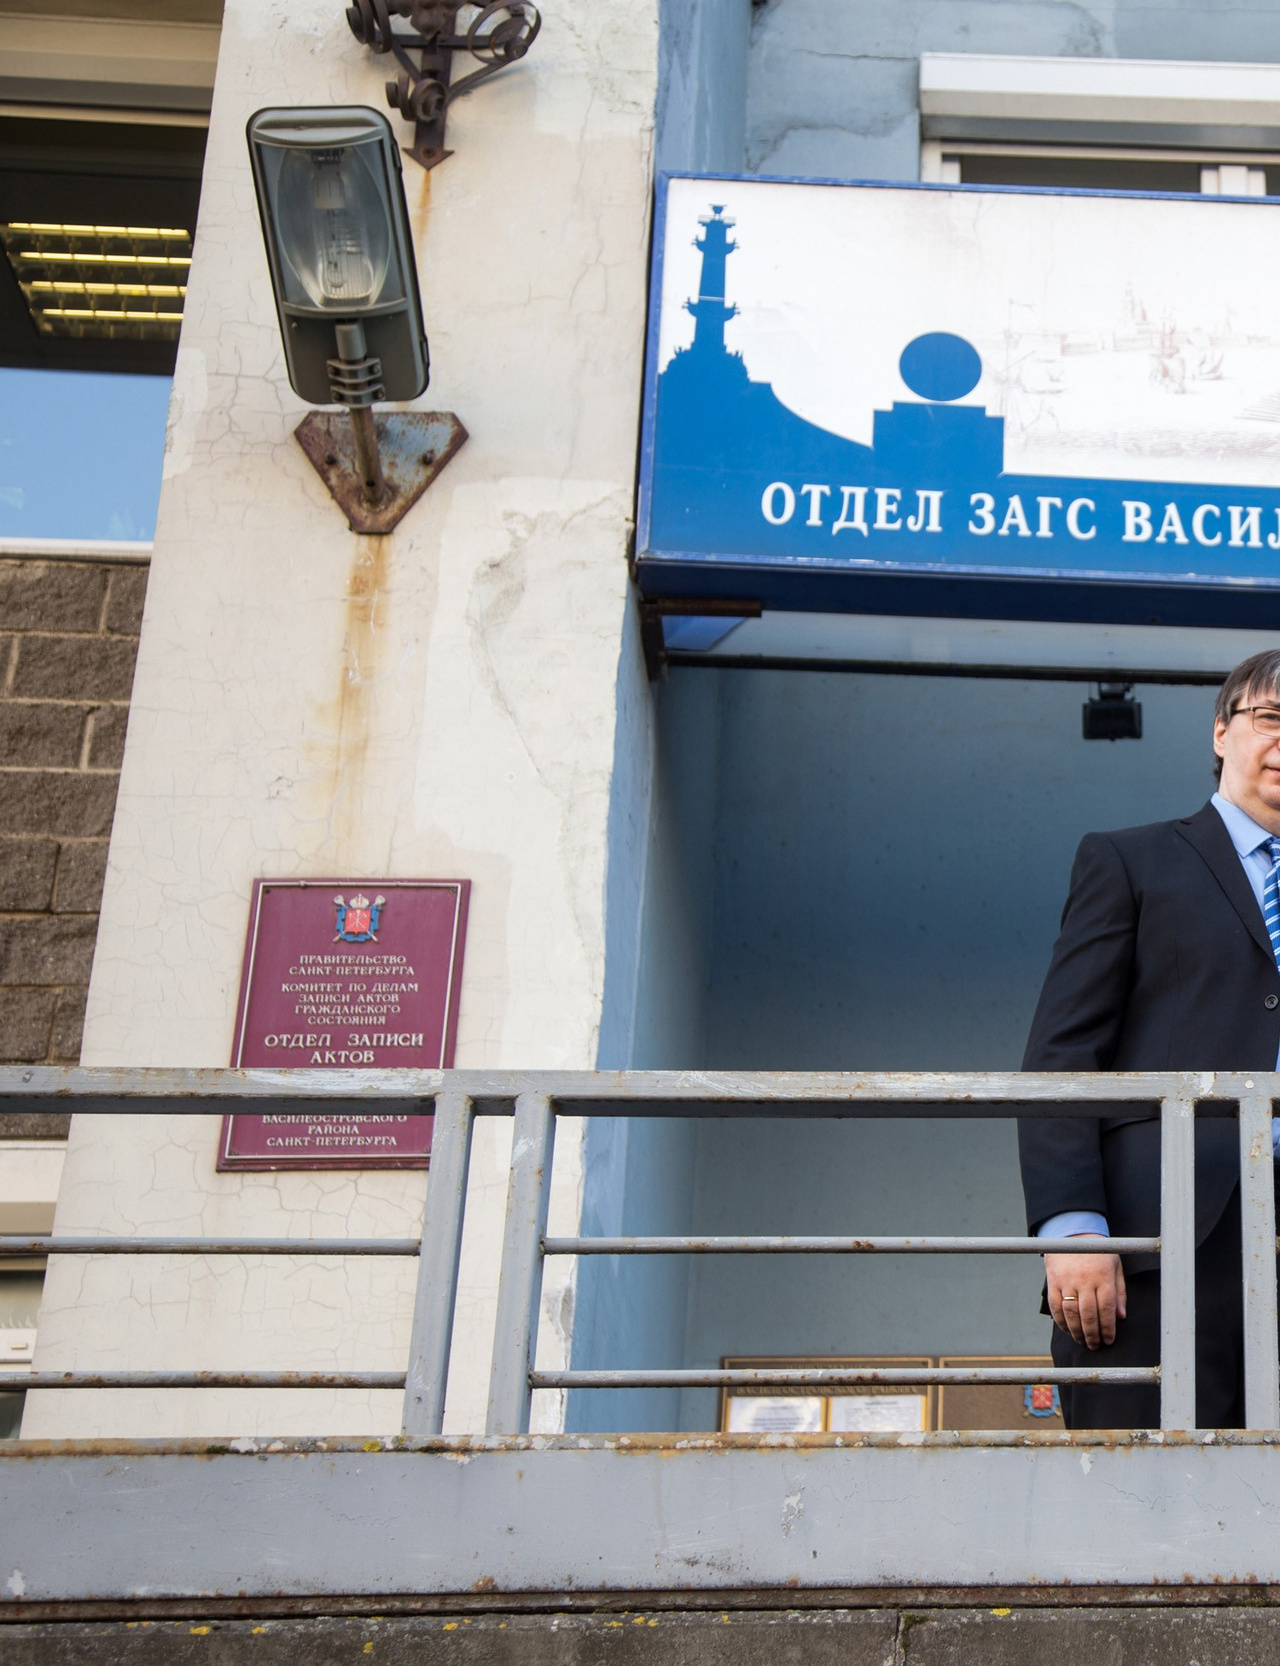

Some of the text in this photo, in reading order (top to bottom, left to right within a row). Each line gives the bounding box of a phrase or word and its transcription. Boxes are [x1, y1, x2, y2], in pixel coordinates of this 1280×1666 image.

[760, 480, 943, 538] ОТДЕЛ
[967, 491, 1098, 541] ЗАГС
[299, 954, 407, 965] ПРАВИТЕЛЬСТВО
[288, 966, 415, 976] САНКТ-ПЕТЕРБУРГА
[281, 982, 419, 993] КОМИТЕТ ПО ДЕЛАМ
[298, 993, 399, 1003] ЗАПИСИ АКТОВ
[294, 1004, 401, 1015] ГРАЖДАНСКОГО
[307, 1015, 386, 1026] СОСТОЯНИЯ
[264, 1032, 424, 1049] ОТДЕЛ ЗАПИСИ
[309, 1050, 376, 1065] АКТОВ
[307, 1124, 360, 1135] РАЙОНА
[266, 1136, 398, 1147] САНКТ-ПЕТЕРБУРГА
